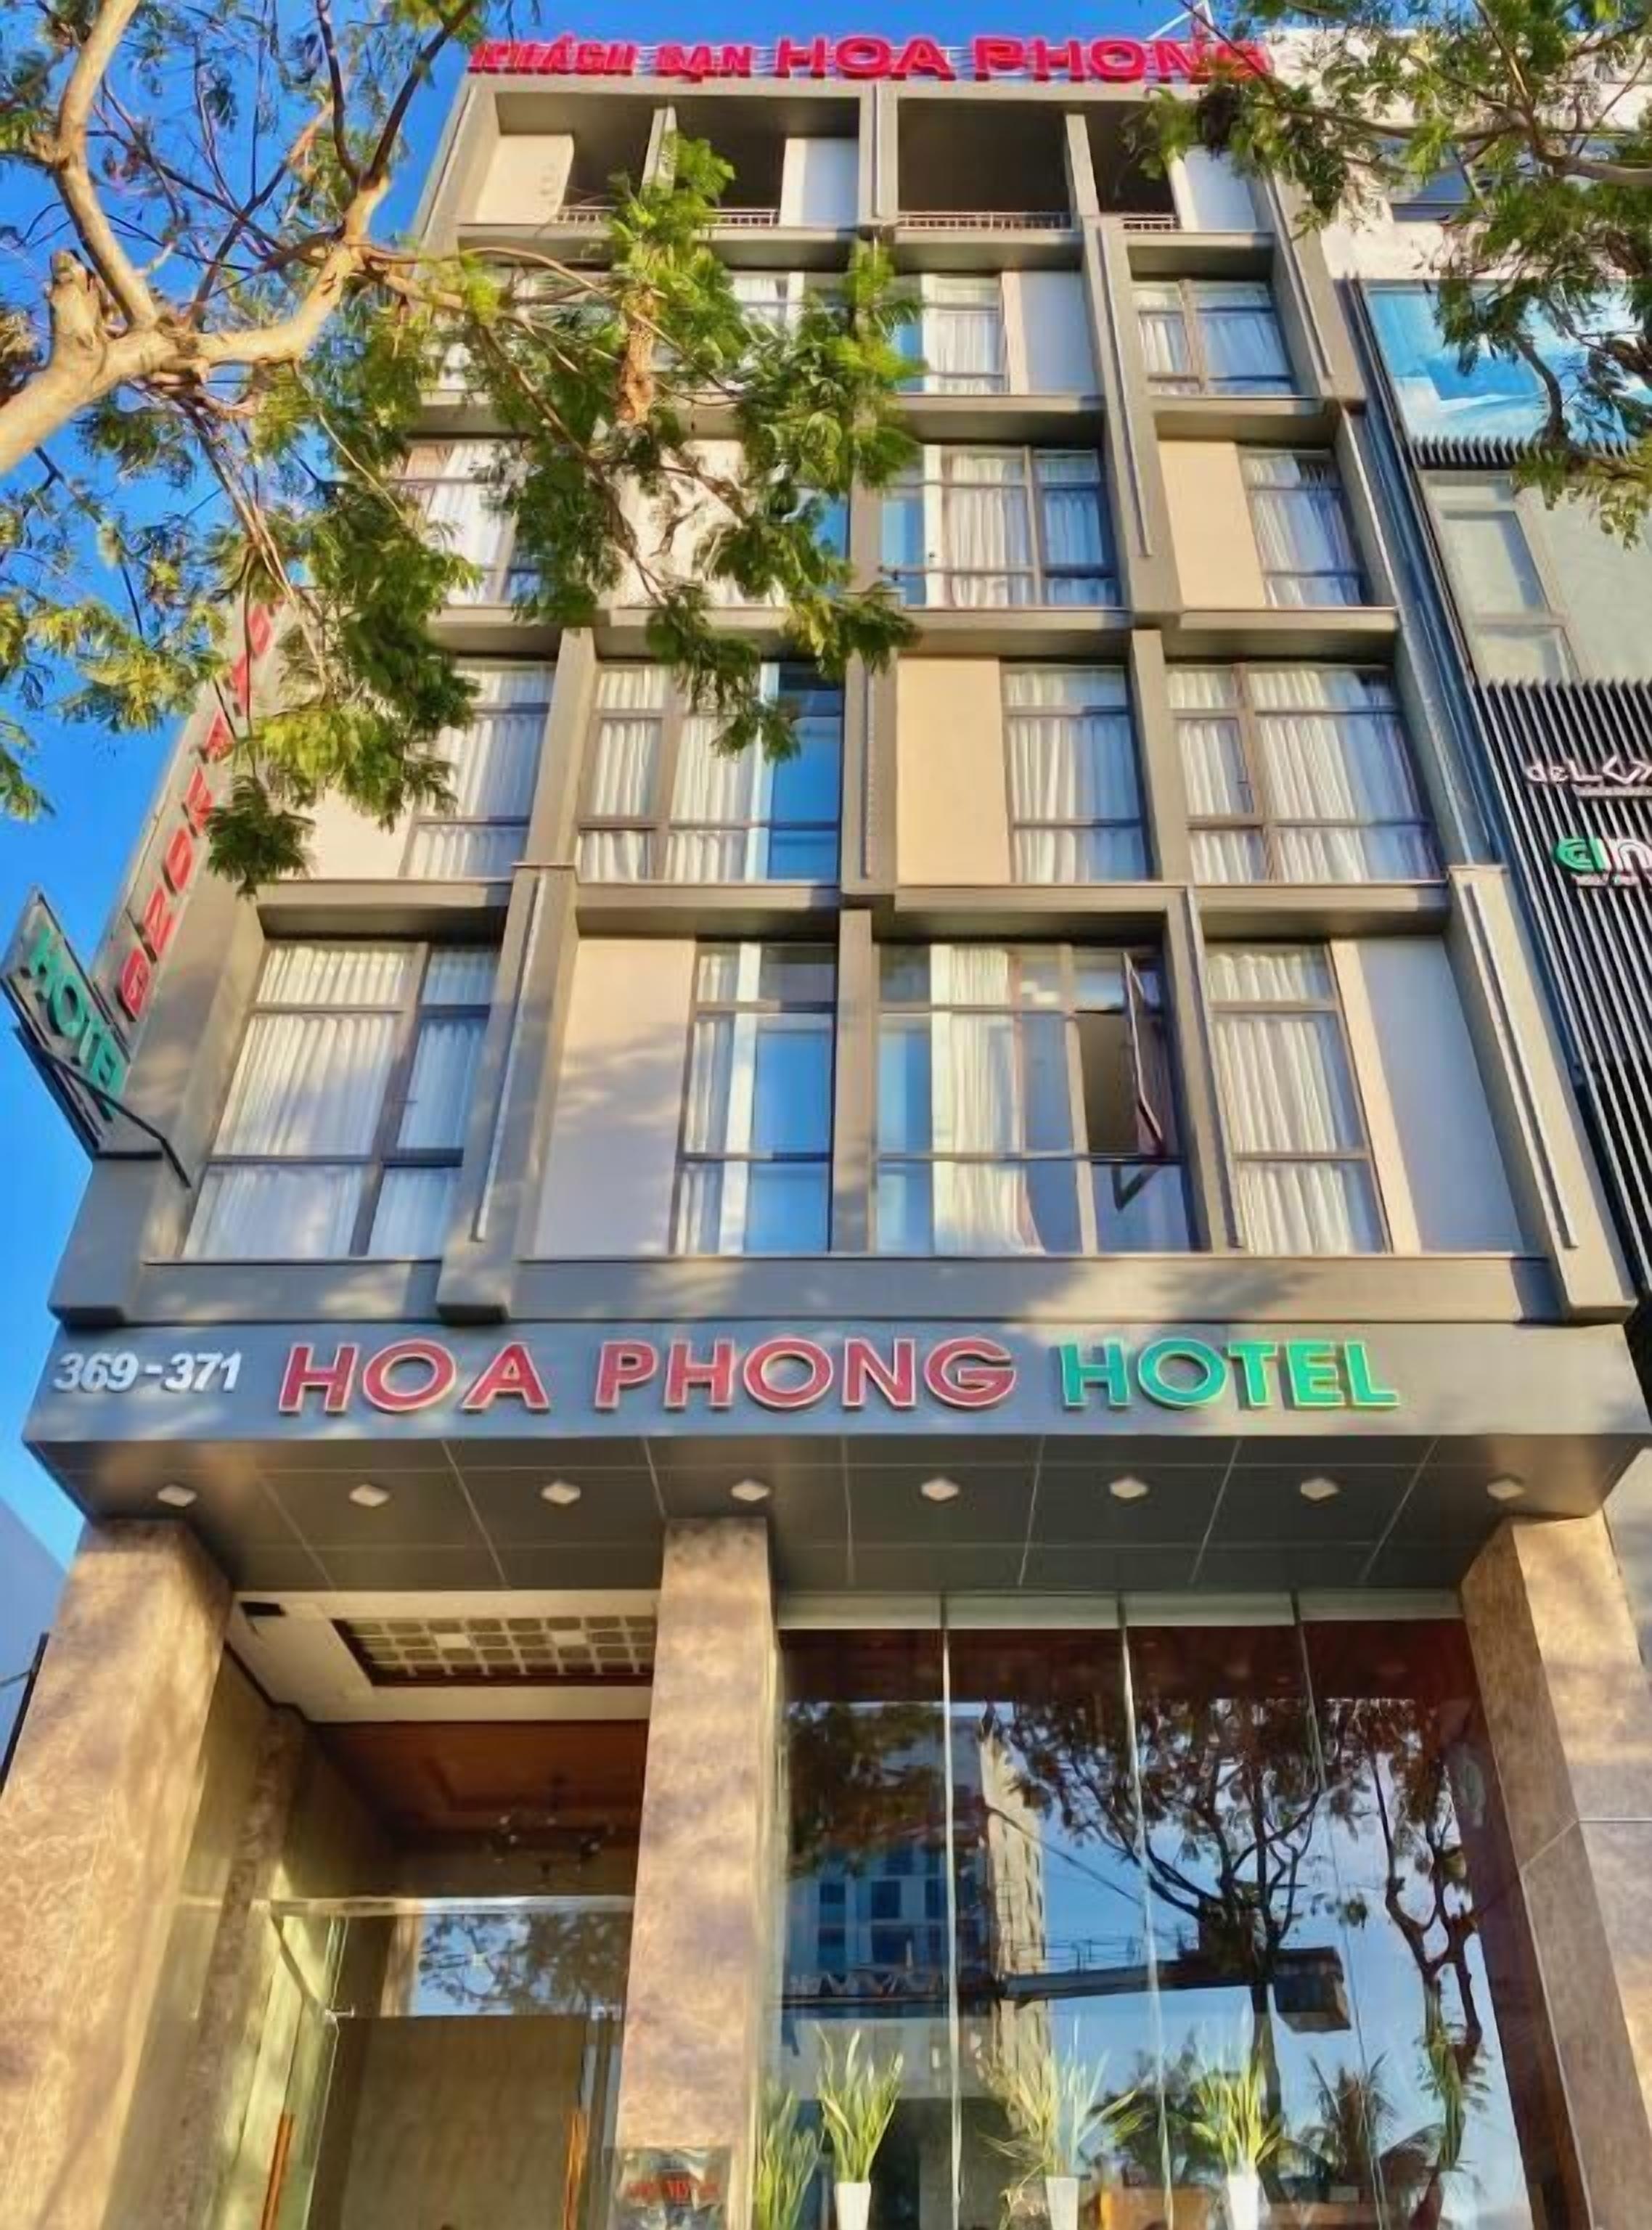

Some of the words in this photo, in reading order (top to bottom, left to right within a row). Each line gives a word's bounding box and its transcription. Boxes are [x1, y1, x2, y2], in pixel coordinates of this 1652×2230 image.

[774, 36, 956, 81] HOA
[53, 1352, 244, 1394] 369-371
[278, 1340, 549, 1413] HOA
[594, 1337, 1018, 1412] PHONG
[1059, 1337, 1401, 1412] HOTEL
